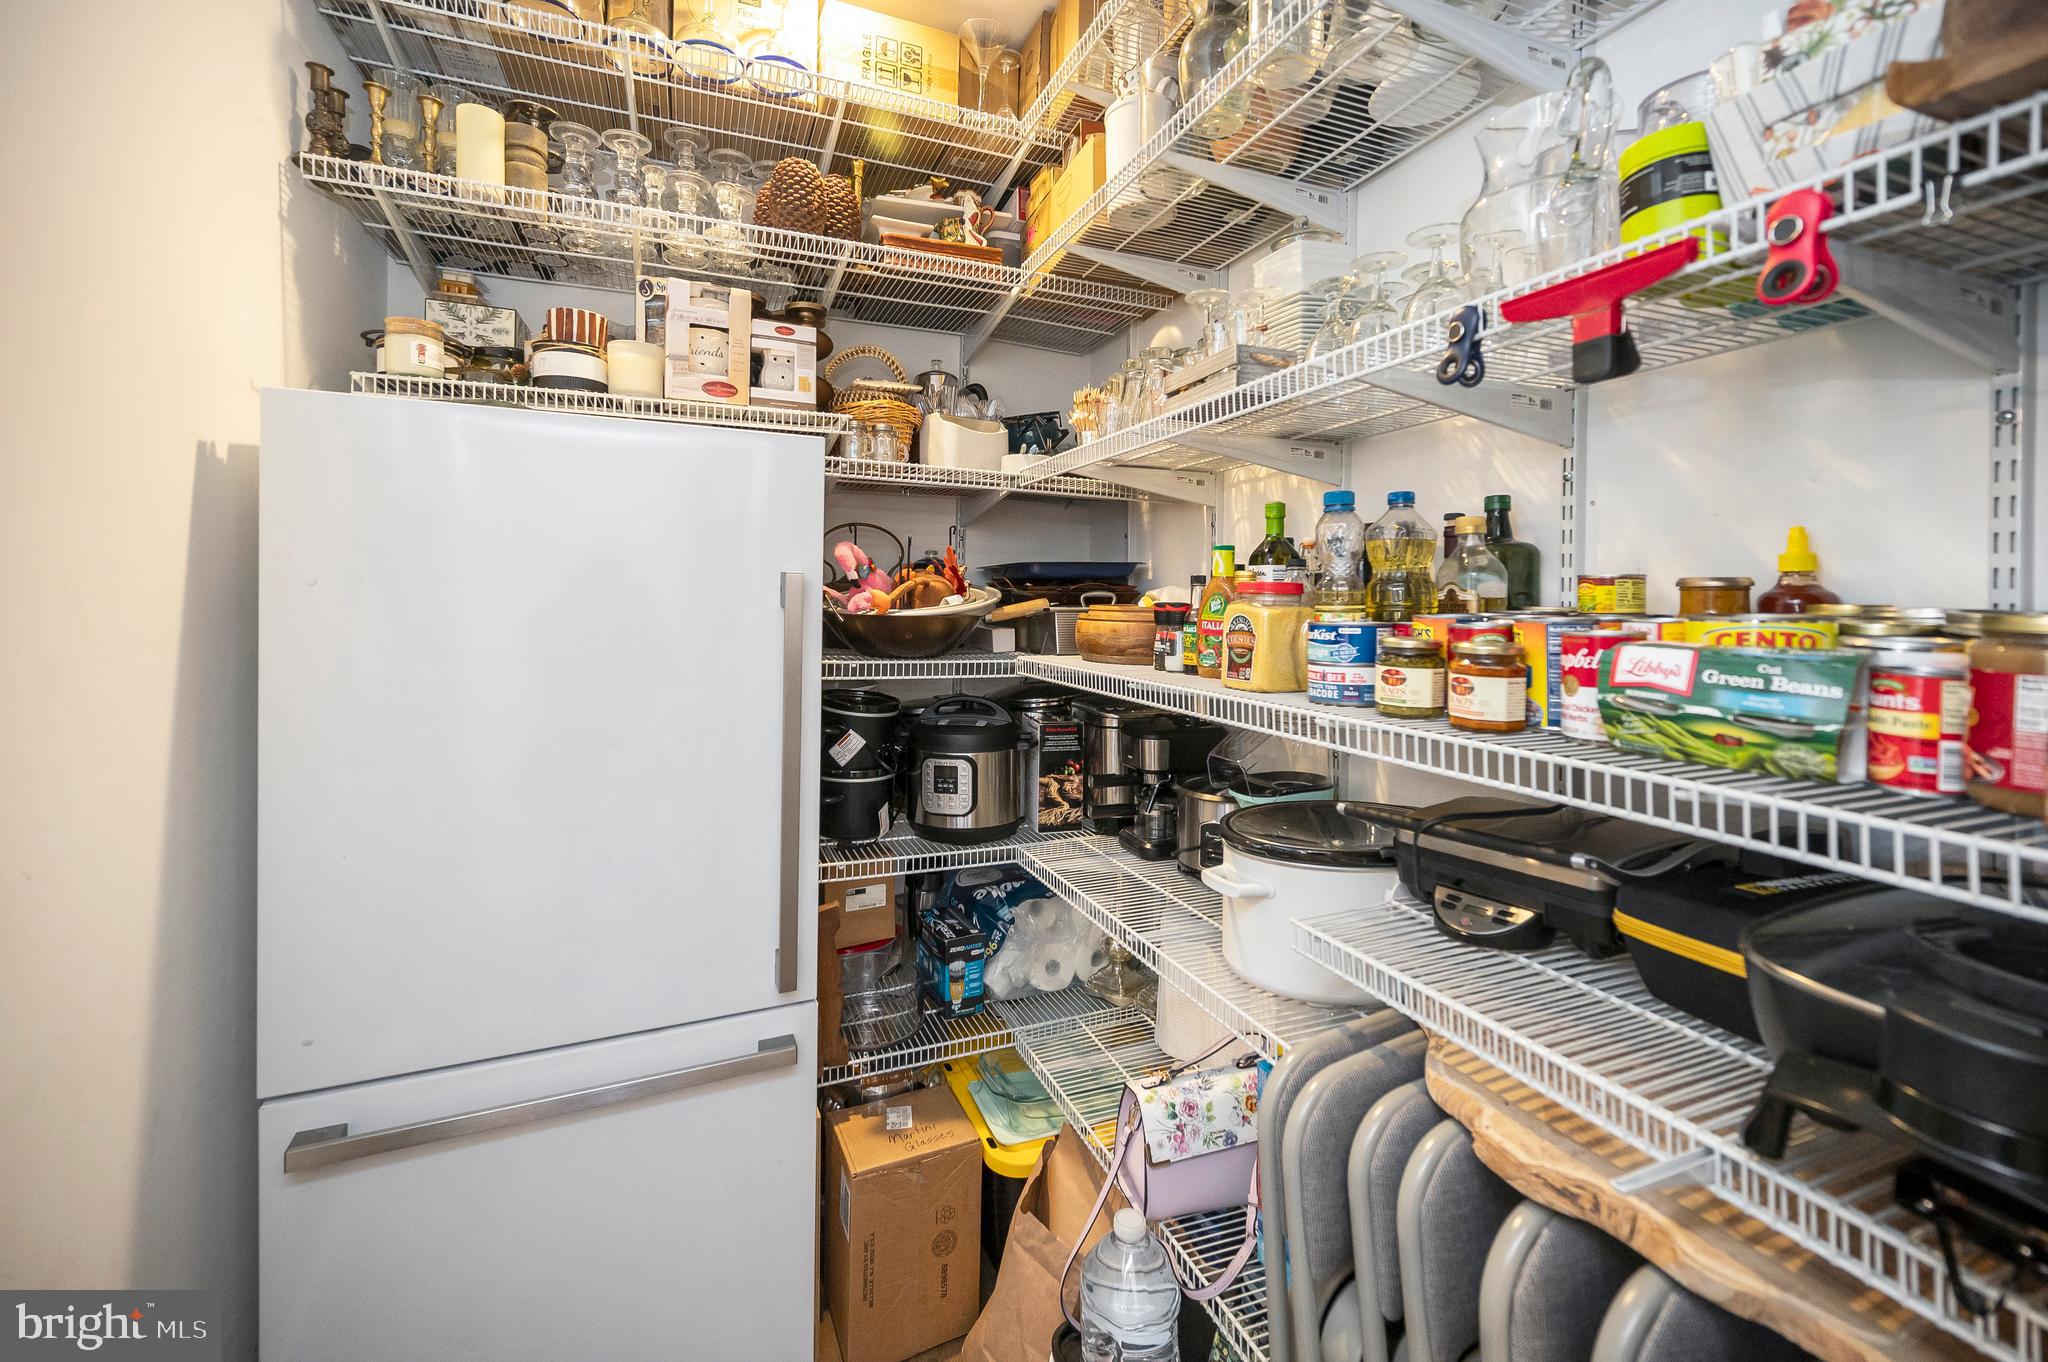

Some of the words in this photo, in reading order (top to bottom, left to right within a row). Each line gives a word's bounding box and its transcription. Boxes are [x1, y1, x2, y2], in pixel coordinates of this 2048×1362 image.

[861, 33, 871, 81] FRAGILE
[656, 281, 667, 292] Sp
[1201, 620, 1224, 631] ITALIA
[1715, 632, 1818, 649] CENTO
[1562, 648, 1605, 671] pbel
[1622, 656, 1683, 679] Libby's
[1756, 663, 1782, 675] Cut
[1701, 668, 1765, 690] Green
[1770, 675, 1844, 699] Beans
[888, 1123, 937, 1145] Martini
[904, 1129, 955, 1152] Glasses
